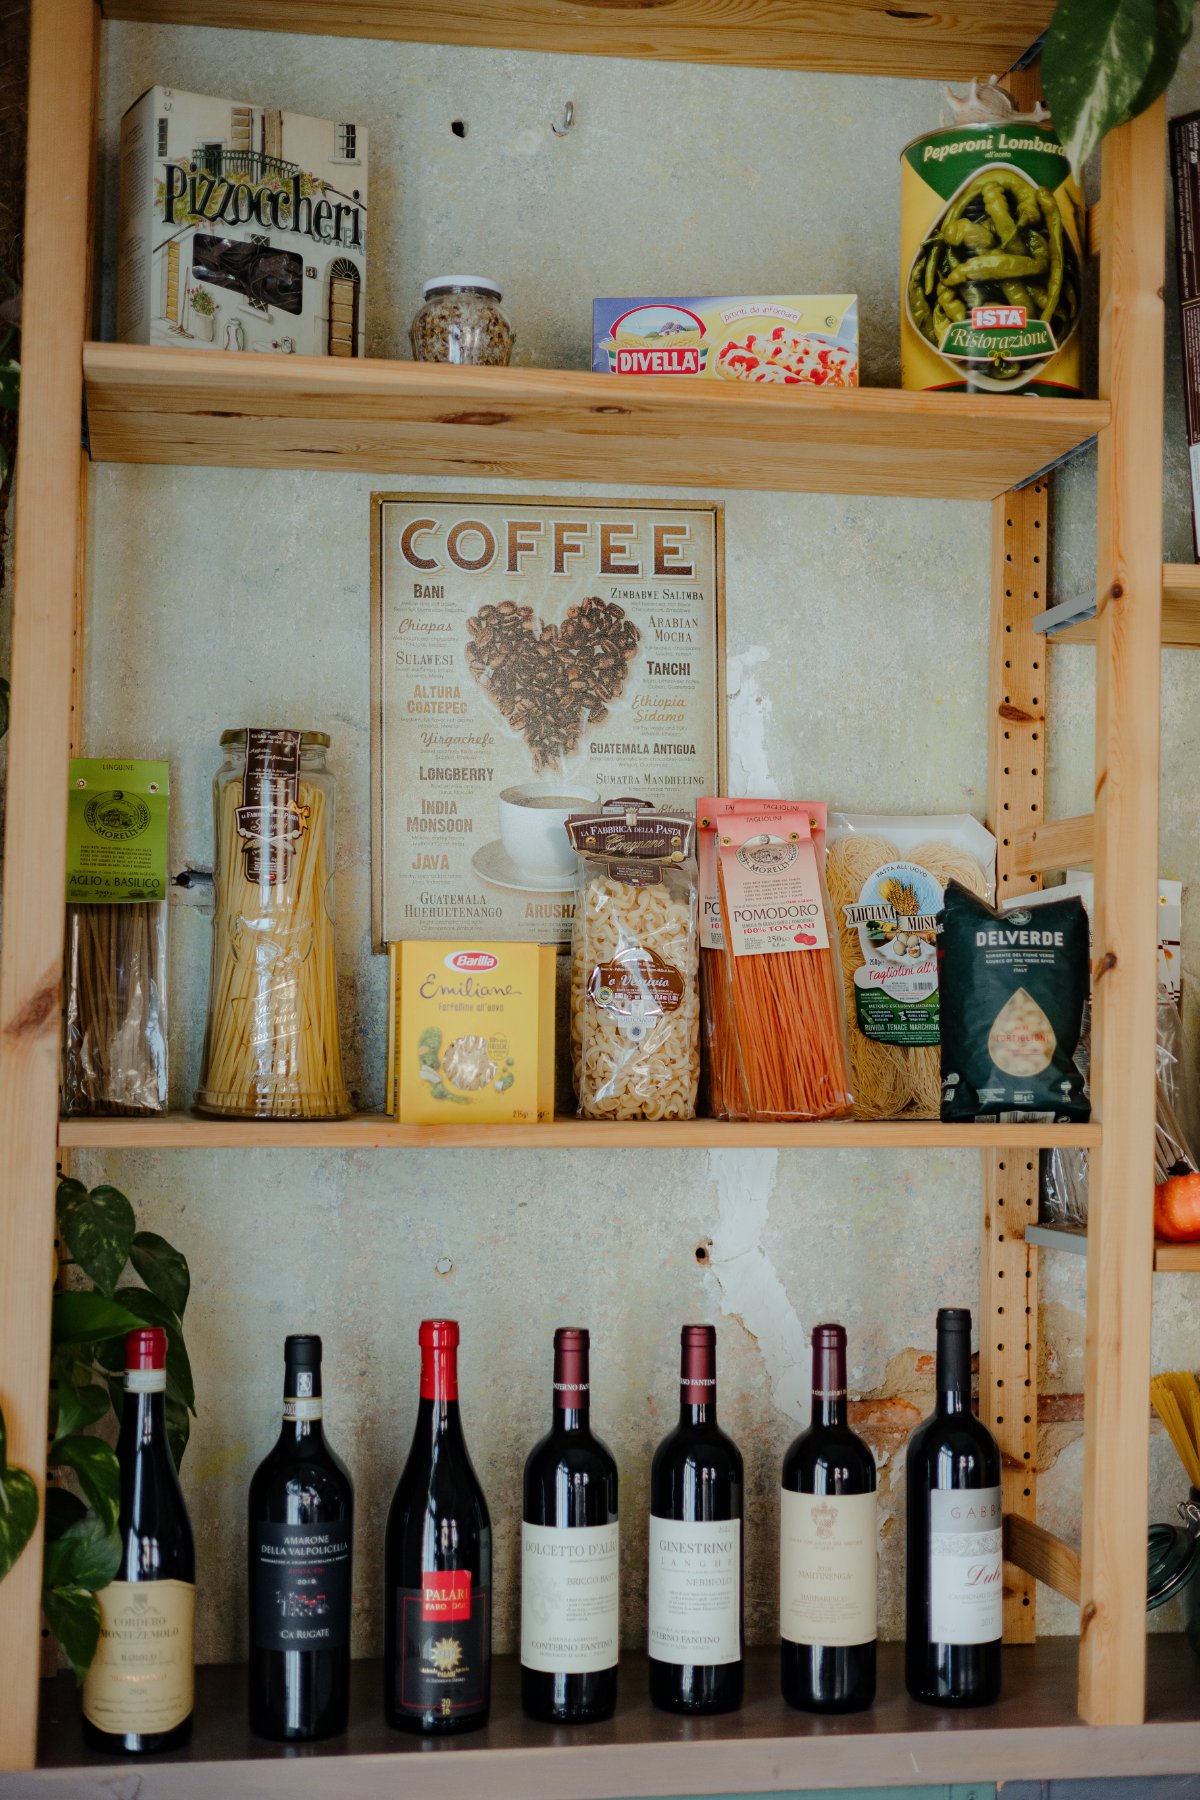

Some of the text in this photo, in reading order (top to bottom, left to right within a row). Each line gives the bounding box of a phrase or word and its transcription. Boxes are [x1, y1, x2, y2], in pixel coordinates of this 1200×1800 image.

[924, 134, 993, 162] Peperoni
[162, 162, 361, 246] Pizzoccheri
[723, 305, 799, 322] pronti da infornare
[975, 309, 1024, 326] ISTA
[950, 327, 1048, 350] Ristorazione
[620, 351, 697, 372] DIVELLA
[400, 518, 695, 578] COFFEE
[413, 584, 445, 600] BANI
[610, 587, 704, 602] ZIMBABWE SALIMBA
[398, 618, 454, 635] Chiapas
[648, 615, 699, 630] ARABIAN
[654, 629, 692, 643] MOCHA
[395, 651, 454, 667] SULAWESI
[646, 661, 691, 676] TANCHI
[413, 684, 462, 700] ALTURA
[407, 699, 468, 715] COATEPEC
[631, 694, 687, 712] Ethiopia
[633, 709, 684, 723] Sidamo
[419, 731, 497, 746] Yirgachefe
[590, 742, 696, 756] GUATEMALA ANTIGUA
[102, 763, 135, 772] LINGUINE
[419, 766, 495, 782] LONGBERRY
[596, 772, 705, 786] SUMATRA MANDHELING
[421, 799, 458, 815] INDIA
[763, 803, 799, 812] TAGLIOLINI
[406, 816, 474, 833] MONSOON
[746, 815, 782, 823] TAGLIOLINI
[96, 827, 139, 841] MORELLI
[590, 825, 632, 836] FABBRICA
[655, 824, 682, 836] PASTA
[412, 852, 450, 871] JAVA
[749, 861, 792, 874] MORELLI
[875, 863, 928, 879] PASTA ALL'UOVO
[69, 876, 102, 886] AGLIO
[114, 877, 160, 888] BASILICO
[419, 891, 487, 906] GUATEMALA
[404, 905, 503, 919] HUEHUETENANGO
[734, 903, 819, 923] POMODORO
[850, 904, 897, 923] LUCIANA
[743, 922, 816, 935] 100% TOSCANI
[976, 930, 1064, 947] DELVERDE
[455, 955, 494, 967] Barilla
[868, 964, 914, 985] Tagliolini
[420, 973, 523, 999] Emiliane
[438, 1002, 474, 1012] Farfalline
[887, 1023, 907, 1031] TENACE
[909, 1023, 940, 1031] MARCHIGIA
[283, 1535, 330, 1545] AMARONE
[659, 1539, 732, 1554] GINESTRINO
[261, 1542, 348, 1556] DELLA VALPOLICELLA
[525, 1540, 584, 1557] DOLCETTO
[566, 1575, 598, 1586] BRICCO
[685, 1577, 732, 1587] NEBBIOLO
[425, 1588, 469, 1602] PALARI
[113, 1616, 167, 1627] CORDERO
[100, 1628, 181, 1640] MONTEZEMOLO
[296, 1628, 330, 1639] RUGATE
[651, 1630, 721, 1643] NTERNO FANTINO
[531, 1639, 613, 1652] CONTERNO FANTINO
[441, 1698, 451, 1706] 20
[441, 1707, 451, 1715] 16
